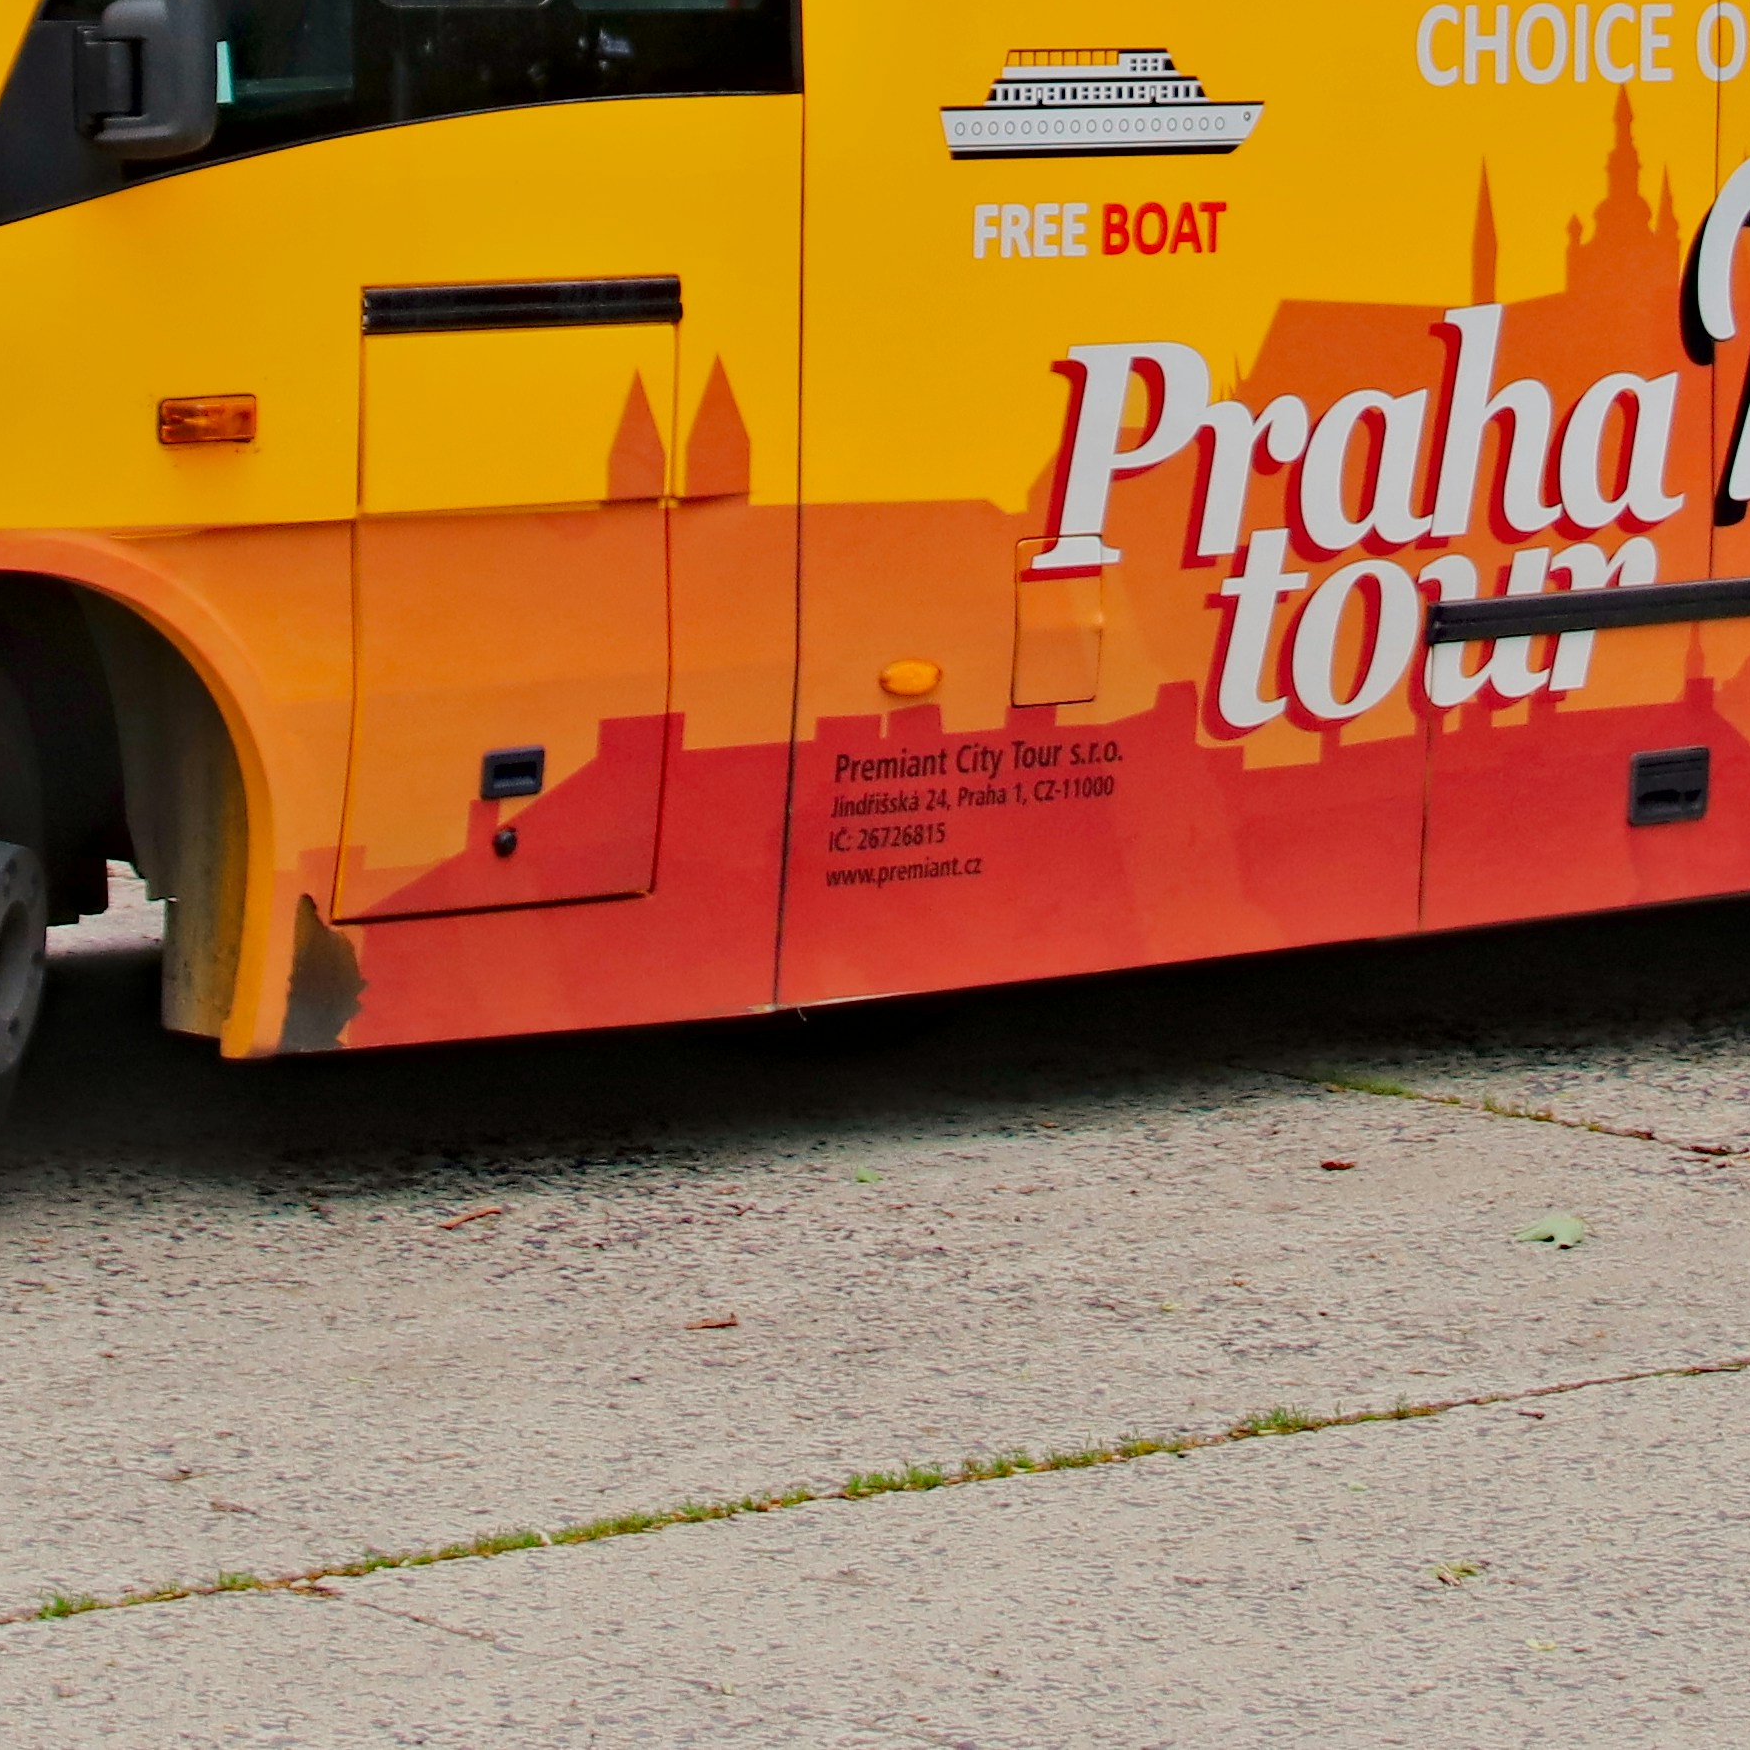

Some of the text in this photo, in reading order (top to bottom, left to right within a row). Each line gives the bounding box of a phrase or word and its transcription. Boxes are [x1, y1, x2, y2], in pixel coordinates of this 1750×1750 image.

[1416, 2, 1673, 86] CHOICE
[972, 200, 1228, 260] FREE BOAT
[1026, 303, 1687, 576] Praha
[1212, 528, 1657, 730] tour
[834, 740, 1123, 783] Premiant City Tour s.r.o.
[830, 775, 1115, 819] Jindřišská 24, Praha 1, CZ-11000
[828, 822, 946, 853] IČ: 26726815
[826, 857, 983, 889] www.premiant.cz
